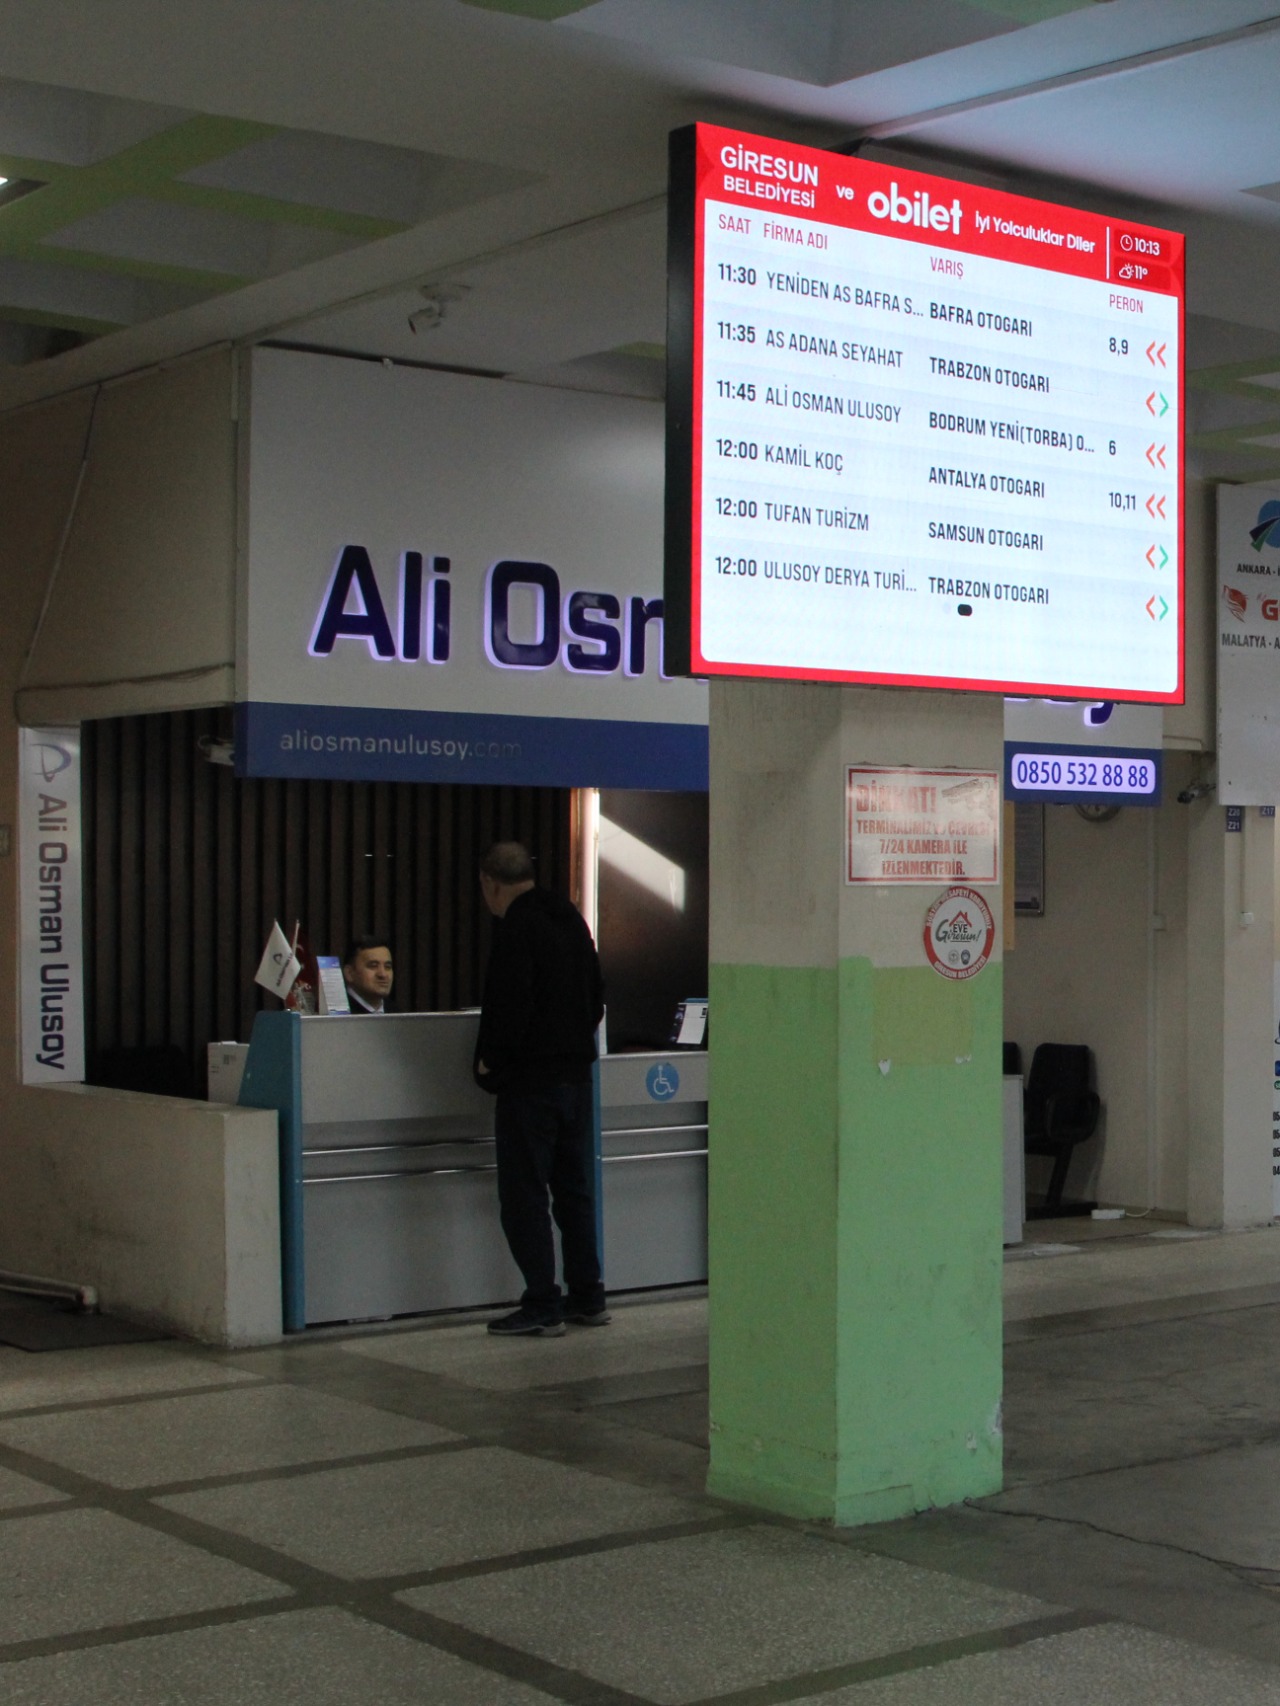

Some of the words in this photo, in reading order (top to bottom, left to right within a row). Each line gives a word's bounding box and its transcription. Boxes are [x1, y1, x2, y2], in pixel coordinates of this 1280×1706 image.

[720, 145, 819, 187] GİRESUN
[723, 175, 816, 209] BELEDİYESİ
[836, 185, 854, 201] ve
[868, 183, 963, 235] obilet
[718, 213, 751, 236] SAAT
[763, 220, 804, 245] FİRMA
[807, 231, 828, 251] ADI
[992, 216, 1065, 248] Yolculuklar
[1067, 233, 1095, 253] Diler
[1134, 238, 1161, 256] 10:13
[930, 256, 964, 279] VARIŞ
[718, 263, 757, 286] 11:30
[766, 271, 830, 301] YENİDEN
[833, 285, 852, 303] AS
[854, 289, 901, 313] BAFRA
[1109, 296, 1144, 314] PERON
[930, 302, 974, 328] BAFRA
[977, 311, 1033, 337] OTOGARI
[717, 321, 756, 344] 11:35
[766, 331, 785, 350] AS
[788, 334, 839, 359] ADANA
[842, 342, 904, 369] SEYAHAT
[1109, 337, 1129, 357] 8,9
[930, 357, 992, 384] TRABZON
[995, 368, 1050, 394] OTOGARI
[717, 380, 757, 402] 11:45
[765, 384, 789, 407] ALİ
[792, 391, 844, 415] OSMAN
[847, 397, 902, 423] ULUSOY
[929, 411, 987, 437] BODRUM
[990, 417, 1073, 452] YENİ(TORBA)
[1109, 438, 1117, 456] 6
[716, 438, 758, 461] 12:00
[764, 444, 812, 469] KAMİL
[815, 450, 844, 476] KOÇ
[929, 466, 987, 491] ANTALYA
[990, 474, 1046, 499] OTOGARI
[716, 497, 758, 519] 12:00
[764, 503, 812, 526] TUFAN
[816, 506, 870, 532] TURİZM
[1108, 491, 1137, 513] 10,11
[929, 521, 985, 546] SAMSUN
[988, 527, 1044, 552] OTOGARI
[715, 556, 758, 578] 12:00
[764, 560, 822, 585] ULUSOY
[825, 566, 871, 589] DERYA
[874, 569, 918, 594] TURİ...
[1237, 563, 1272, 577] ANKARA
[308, 544, 452, 663] Ali
[929, 576, 991, 600] TRABZON
[994, 582, 1050, 606] OTOGARI
[1221, 632, 1267, 650] MALATYA
[279, 729, 524, 761] aliosmanulusoy.com
[1017, 760, 1062, 785] 0850
[1067, 762, 1098, 787] 532
[1102, 764, 1124, 788] 88
[1128, 765, 1149, 788] 88
[37, 792, 69, 833] Ali
[879, 839, 905, 855] 7/24
[906, 839, 951, 855] KAMERA
[953, 840, 968, 855] İLE
[882, 858, 966, 876] İZLENMEKTEDİR.
[38, 842, 69, 955] Osman
[953, 924, 968, 933] EVE
[36, 962, 70, 1071] Ulusoy
